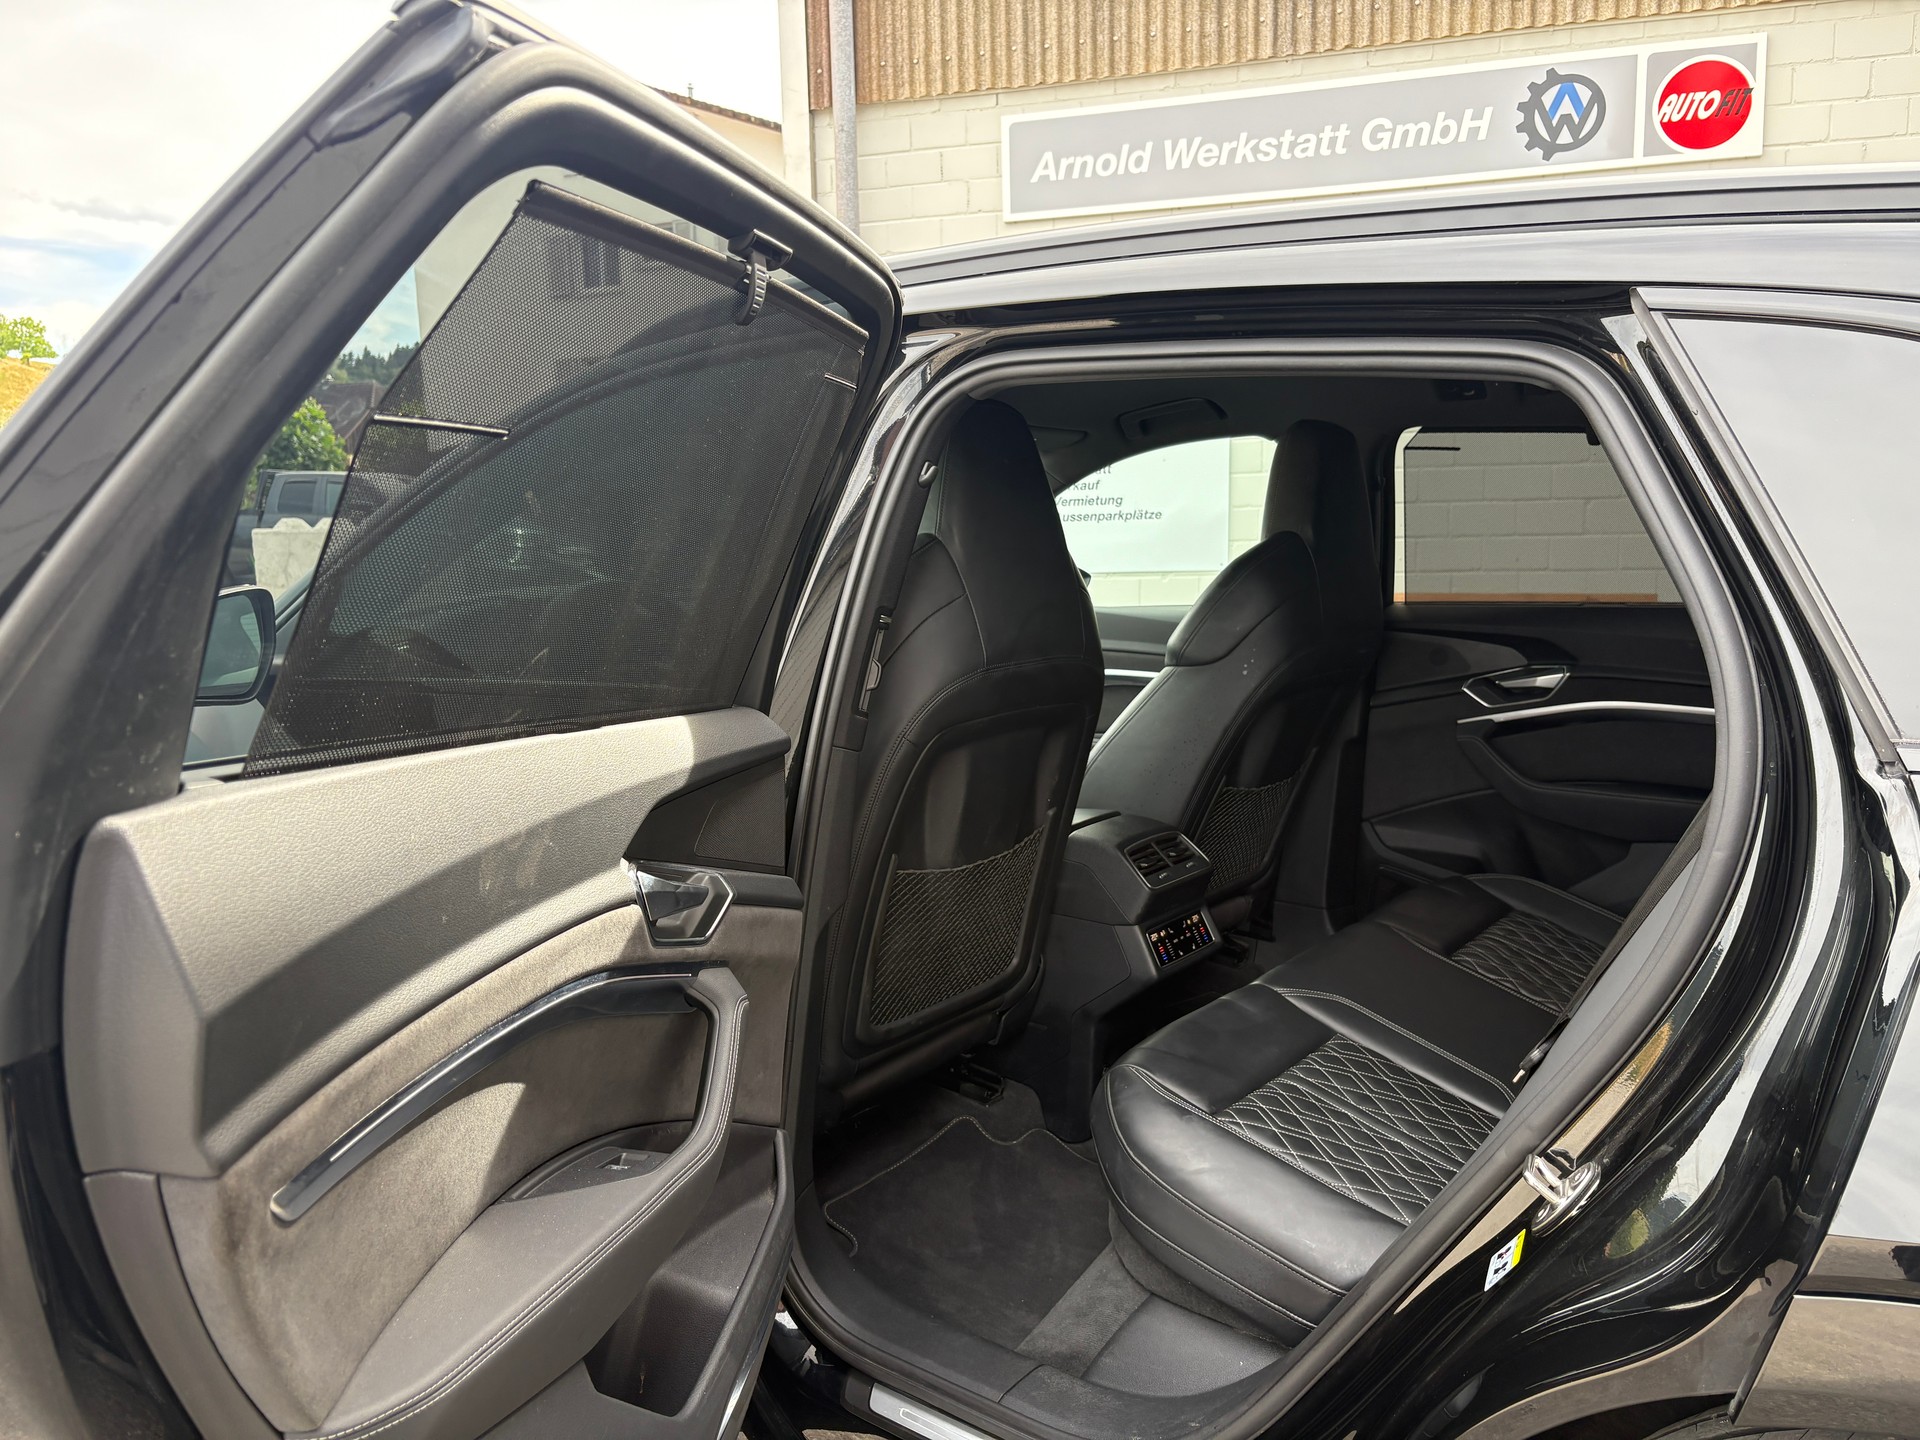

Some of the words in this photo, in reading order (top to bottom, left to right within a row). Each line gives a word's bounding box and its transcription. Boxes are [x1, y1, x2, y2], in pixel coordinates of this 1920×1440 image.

[1658, 87, 1754, 123] AUTOFIT
[1030, 142, 1153, 183] Arnold
[1164, 123, 1350, 169] Werkstatt
[1361, 106, 1493, 152] GmbH
[1062, 509, 1162, 523] ussenparkplätze
